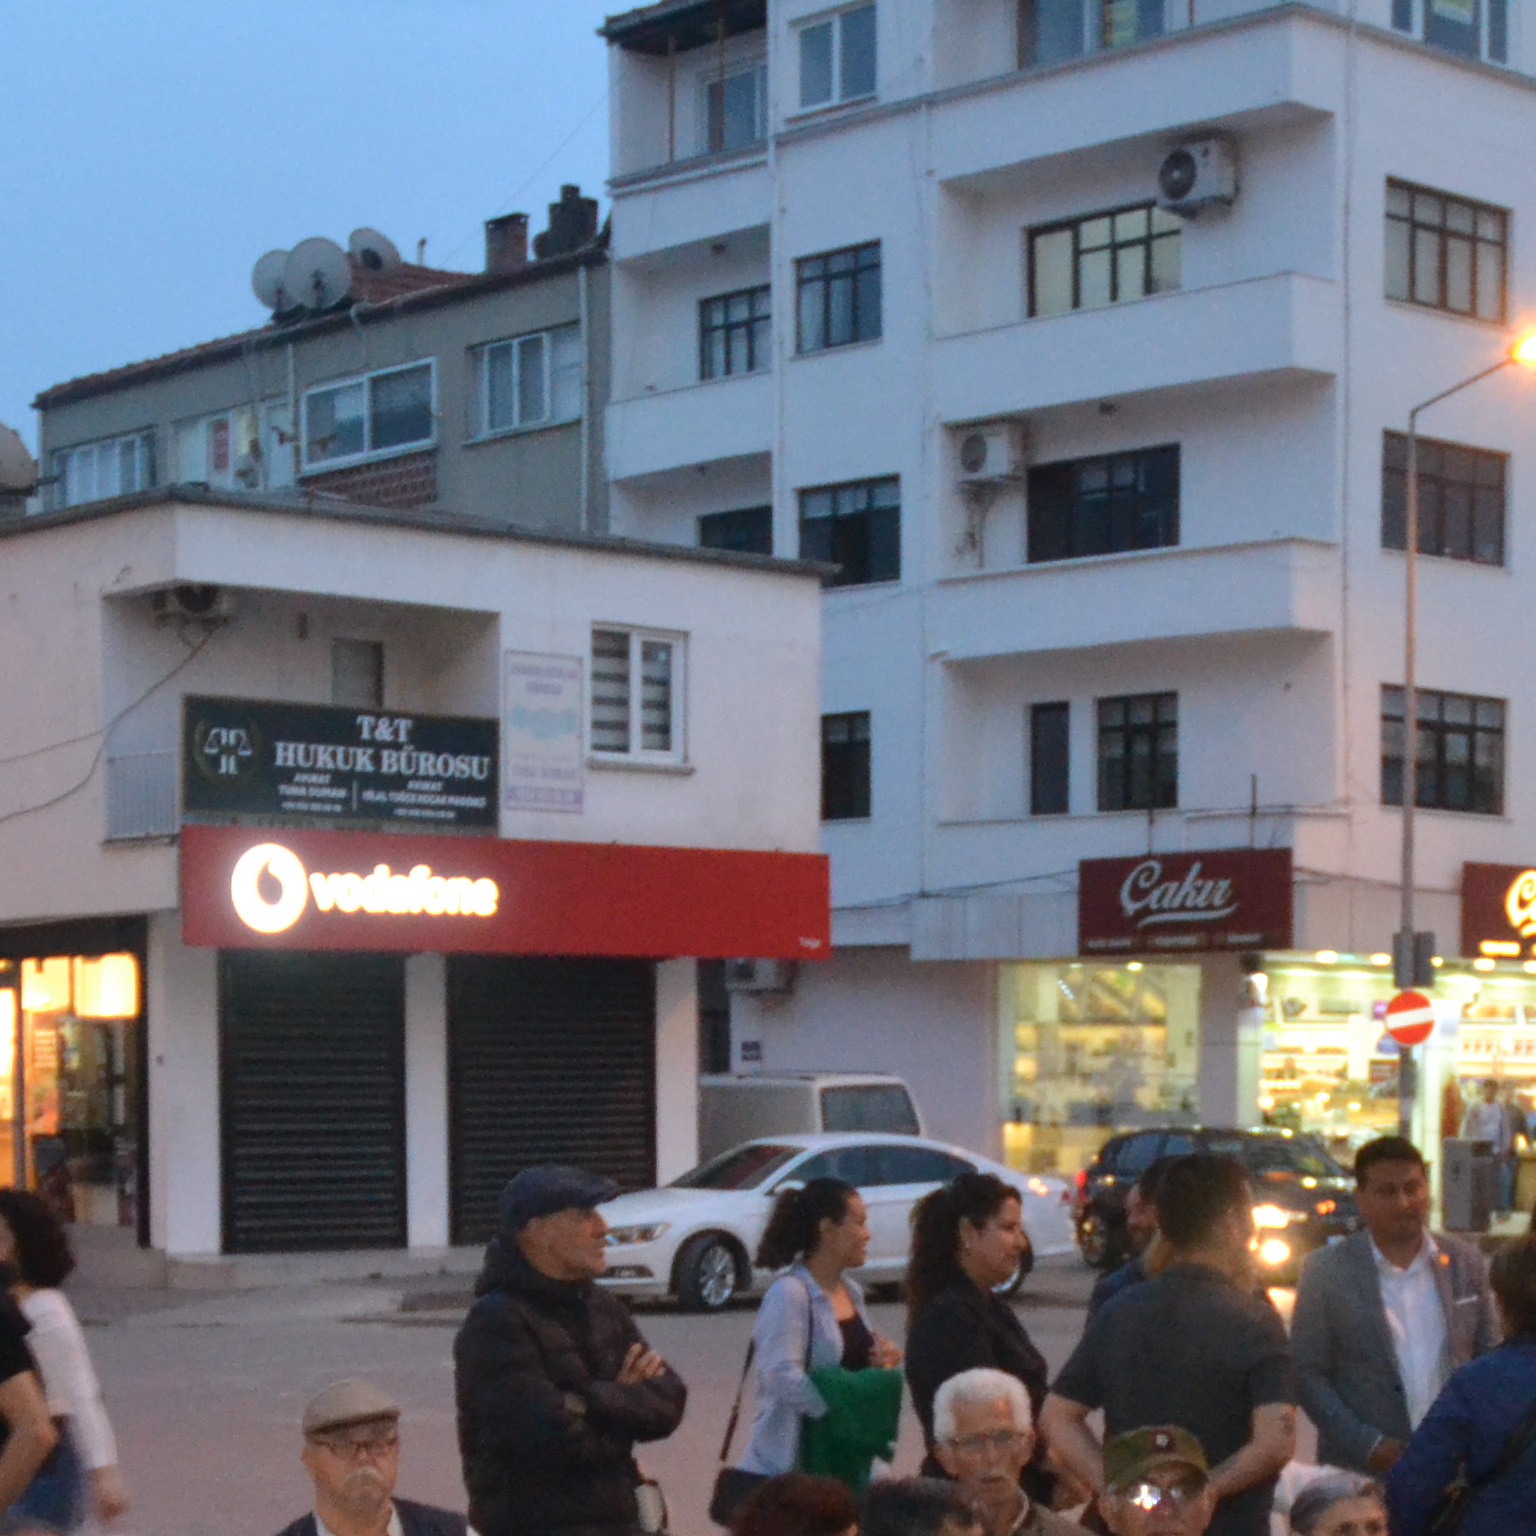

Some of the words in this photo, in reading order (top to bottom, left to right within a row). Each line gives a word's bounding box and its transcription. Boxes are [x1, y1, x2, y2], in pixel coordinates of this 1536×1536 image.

[356, 715, 413, 742] T&T
[274, 741, 375, 773] HUKUK
[380, 745, 490, 780] BÜROSU
[309, 863, 500, 916] vodafone
